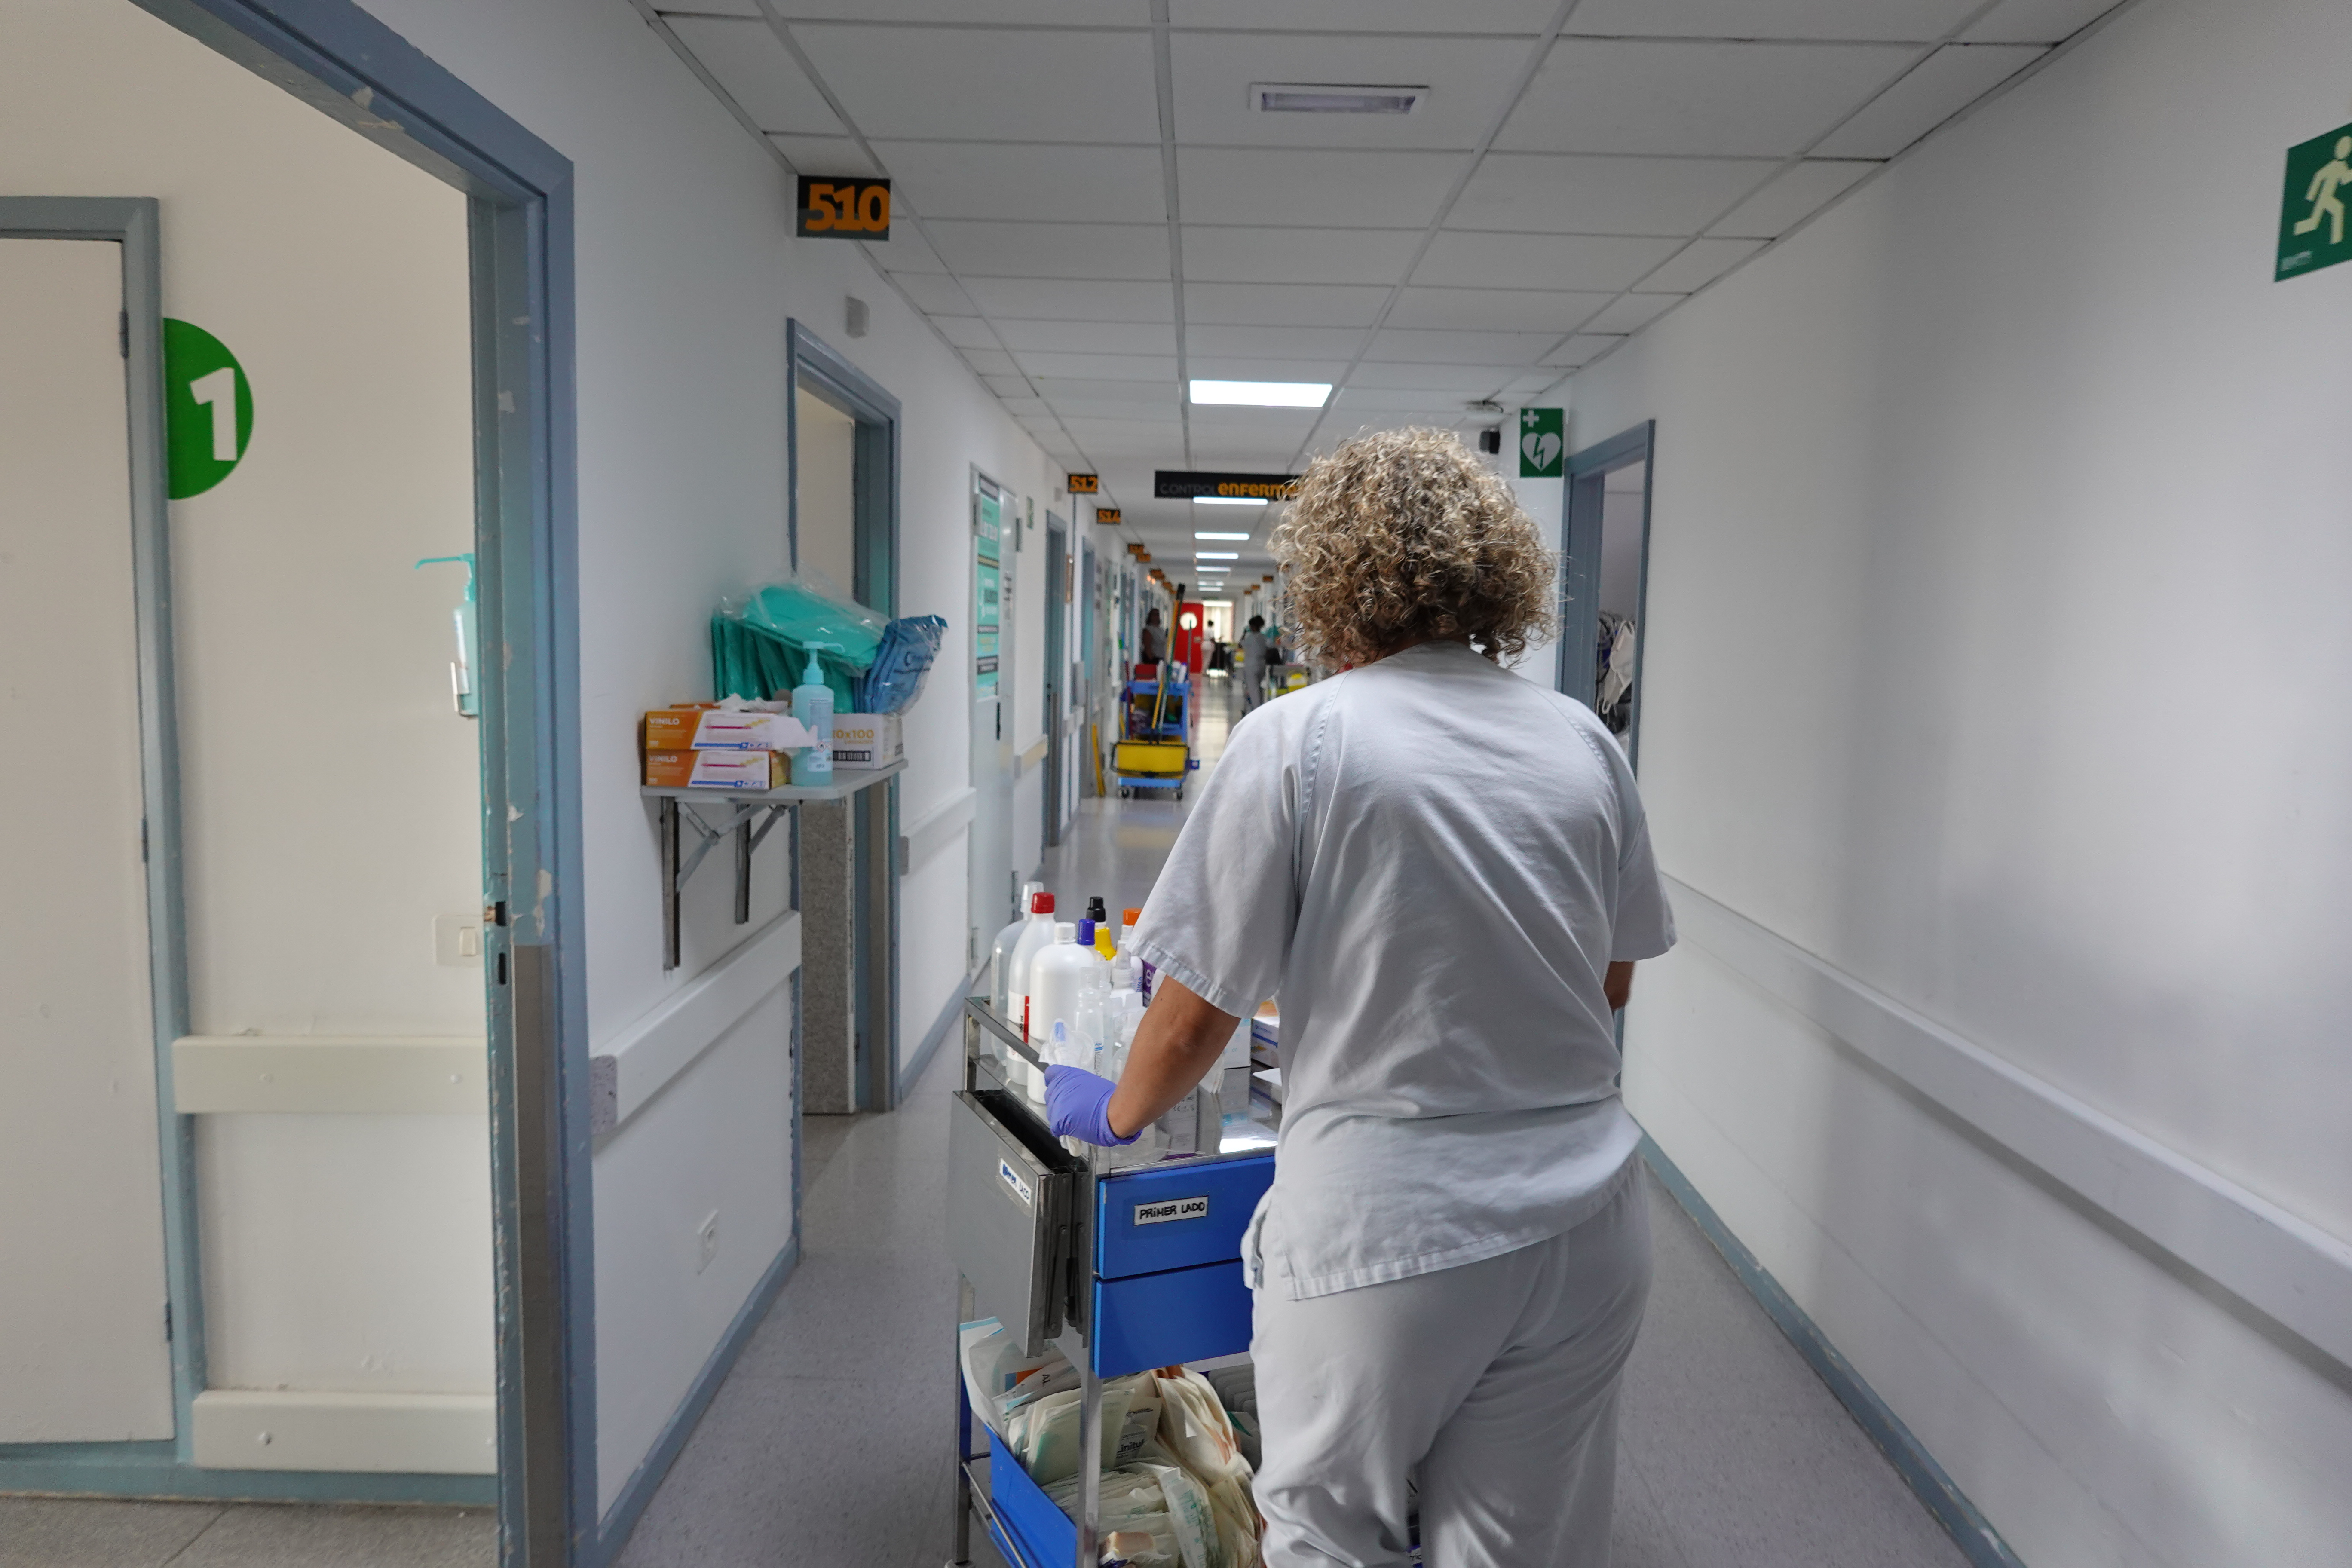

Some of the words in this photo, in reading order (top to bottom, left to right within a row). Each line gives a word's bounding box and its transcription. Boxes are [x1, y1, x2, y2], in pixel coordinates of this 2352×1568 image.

[805, 183, 890, 232] 510
[190, 367, 237, 461] 1
[1069, 475, 1098, 493] 512
[1161, 482, 1215, 495] CONTROL
[1097, 509, 1121, 524] 514
[649, 717, 680, 726] VINILO
[1182, 1202, 1205, 1213] LADO
